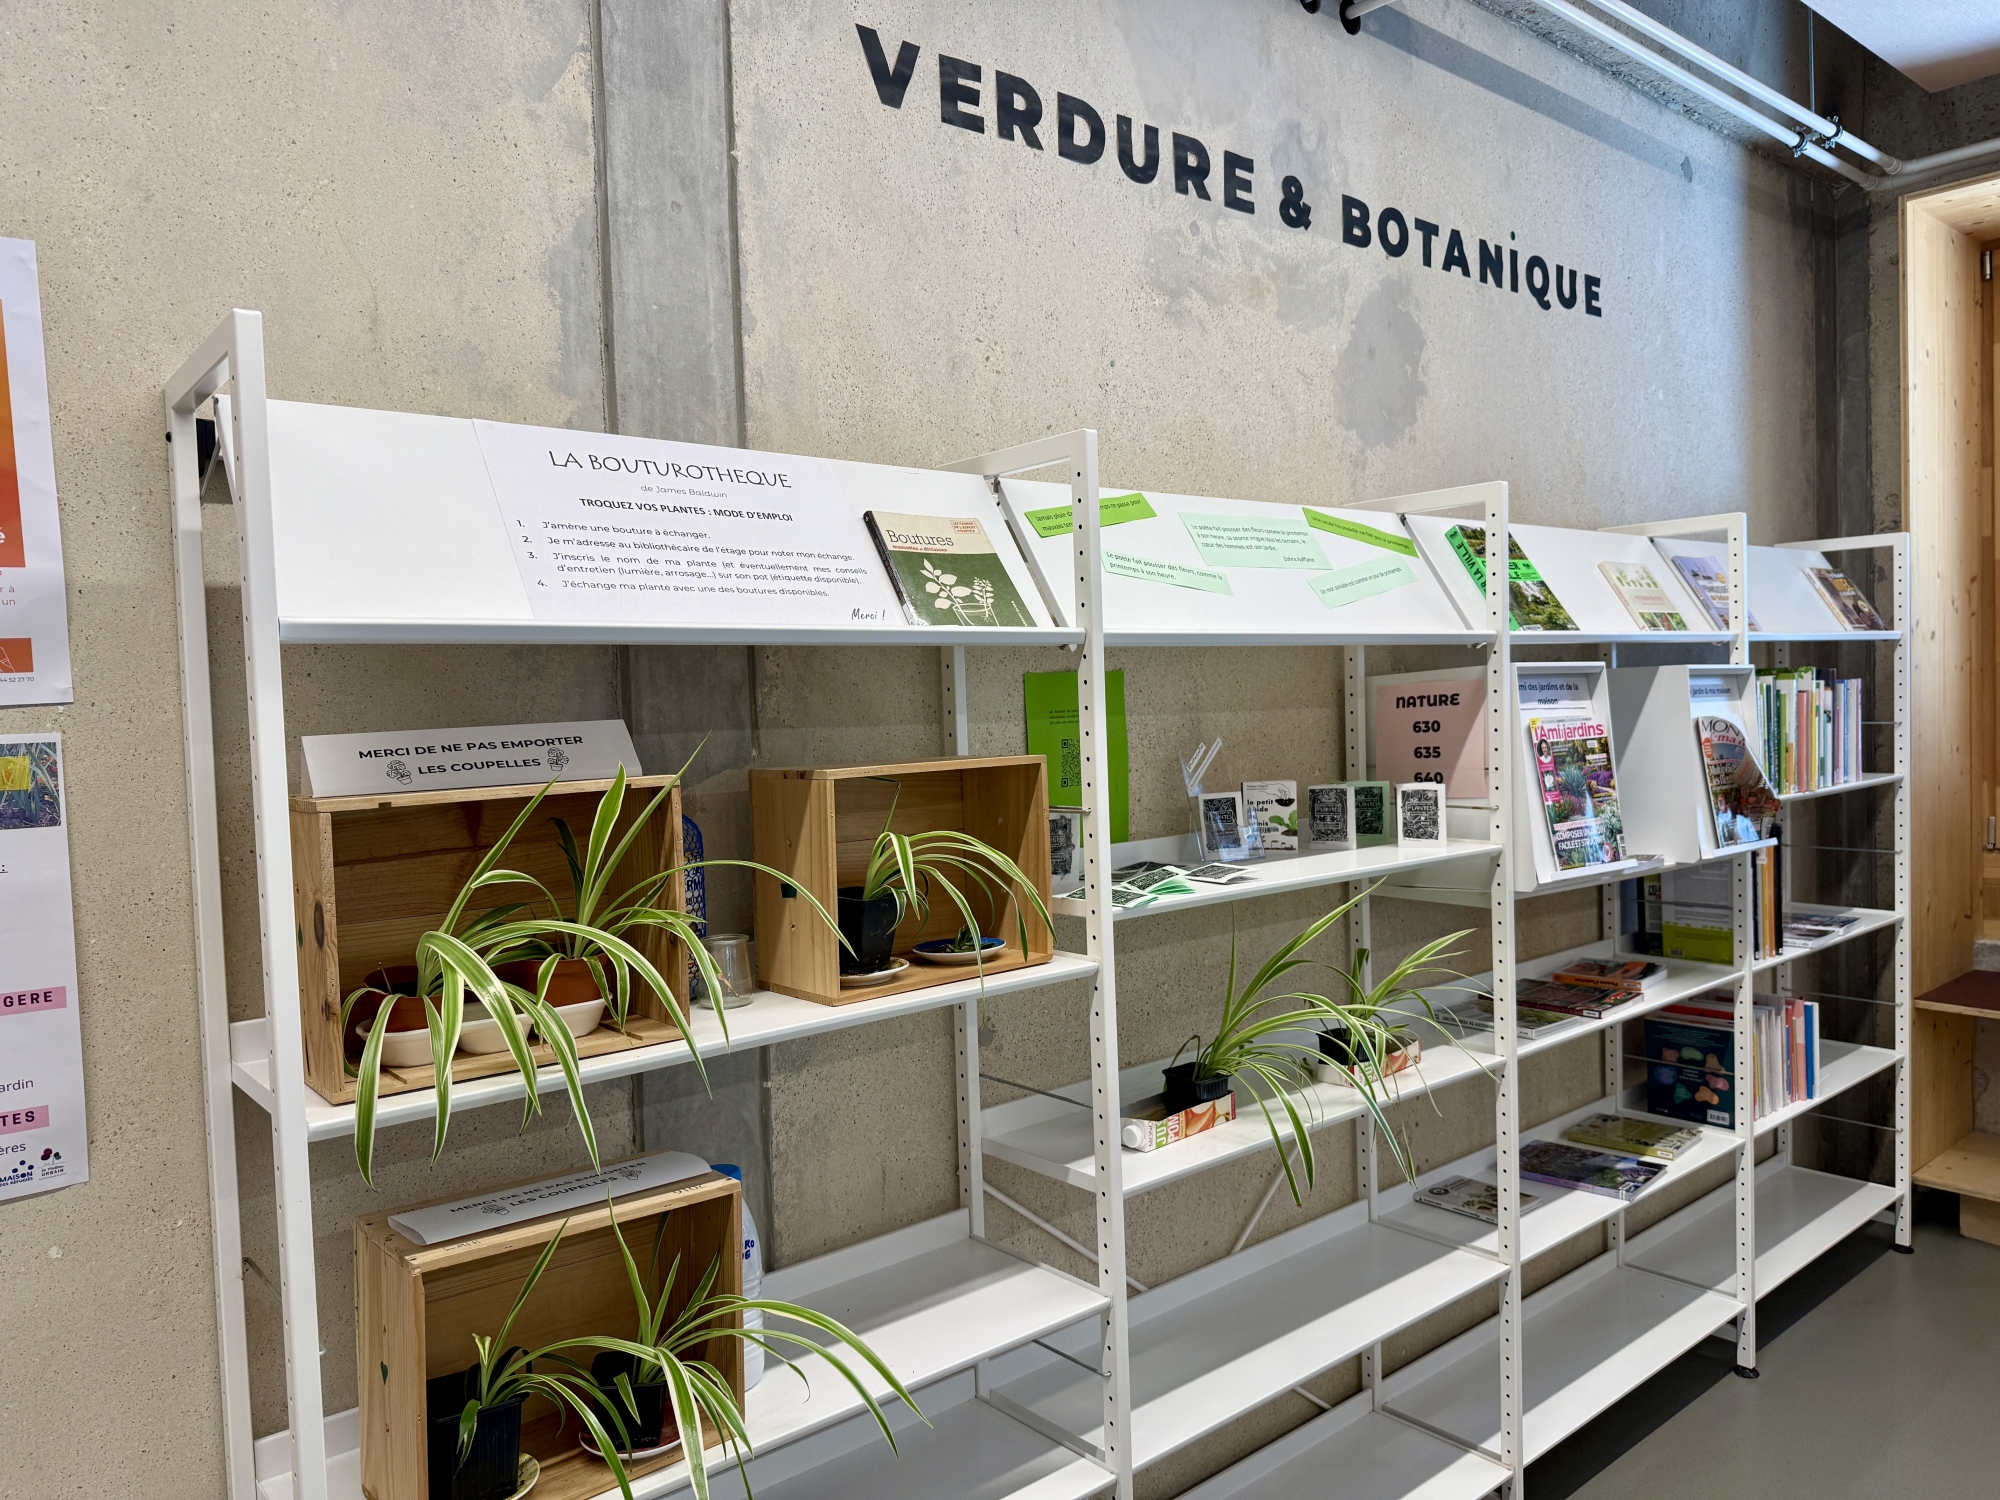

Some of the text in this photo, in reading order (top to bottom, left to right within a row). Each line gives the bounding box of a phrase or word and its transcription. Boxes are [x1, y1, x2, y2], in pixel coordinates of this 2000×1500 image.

[855, 23, 1255, 214] VERDURE
[1279, 175, 1312, 231] &
[549, 451, 792, 489] LA BOUTUROTHEQUE
[640, 484, 728, 498] de James Baldwin
[579, 498, 634, 510] TROQUEZ
[635, 502, 659, 512] VOS
[660, 504, 706, 516] PLANTES
[713, 508, 746, 519] MODE
[746, 510, 794, 522] D'EMPLOI
[516, 519, 711, 540] 1. J'amène une bouture à échanger.
[886, 529, 955, 547] Boutures
[521, 535, 533, 544] 2.
[547, 536, 560, 545] Je
[562, 537, 616, 549] m'adresse
[633, 542, 700, 553] bibliothécaire
[701, 545, 715, 553] de
[715, 546, 747, 557] l'étage
[748, 549, 769, 558] pour
[770, 550, 795, 558] noter
[817, 552, 855, 563] échange.
[526, 551, 538, 559] 3.
[552, 552, 596, 563] J'inscris
[600, 554, 611, 563] le
[646, 556, 660, 565] de
[686, 559, 717, 568] plante
[721, 561, 735, 570] (et
[739, 561, 809, 572] éventuellement
[835, 566, 868, 575] conseils
[557, 564, 616, 575] d'entretien
[618, 567, 663, 577] (lumière,
[752, 573, 769, 583] pot
[770, 573, 813, 584] (étiquette
[813, 575, 862, 585] disponible).
[537, 579, 548, 587] 4.
[561, 580, 617, 591] J'échange
[619, 583, 636, 591] ma
[638, 583, 671, 592] plante
[717, 585, 735, 594] des
[737, 585, 778, 595] boutures
[778, 587, 830, 597] disponibles.
[851, 608, 886, 621] Merci !
[1527, 683, 1538, 691] des
[1538, 682, 1559, 693] jardins
[1559, 683, 1566, 691] et
[1565, 682, 1573, 691] de
[1537, 696, 1559, 705] maison
[1412, 719, 1441, 734] 630
[1701, 719, 1740, 737] MON
[358, 735, 584, 759] MERCI DE NE PAS EMPORTER
[1413, 746, 1442, 759] 635
[417, 758, 541, 775] LES COUPELLES
[1413, 771, 1444, 785] 640
[1256, 798, 1274, 807] petit
[450, 1199, 498, 1214] MERCI
[499, 1193, 519, 1202] DE
[522, 1186, 544, 1196] NE
[546, 1180, 573, 1190] PAS
[509, 1176, 618, 1207] LES COUPELLES
